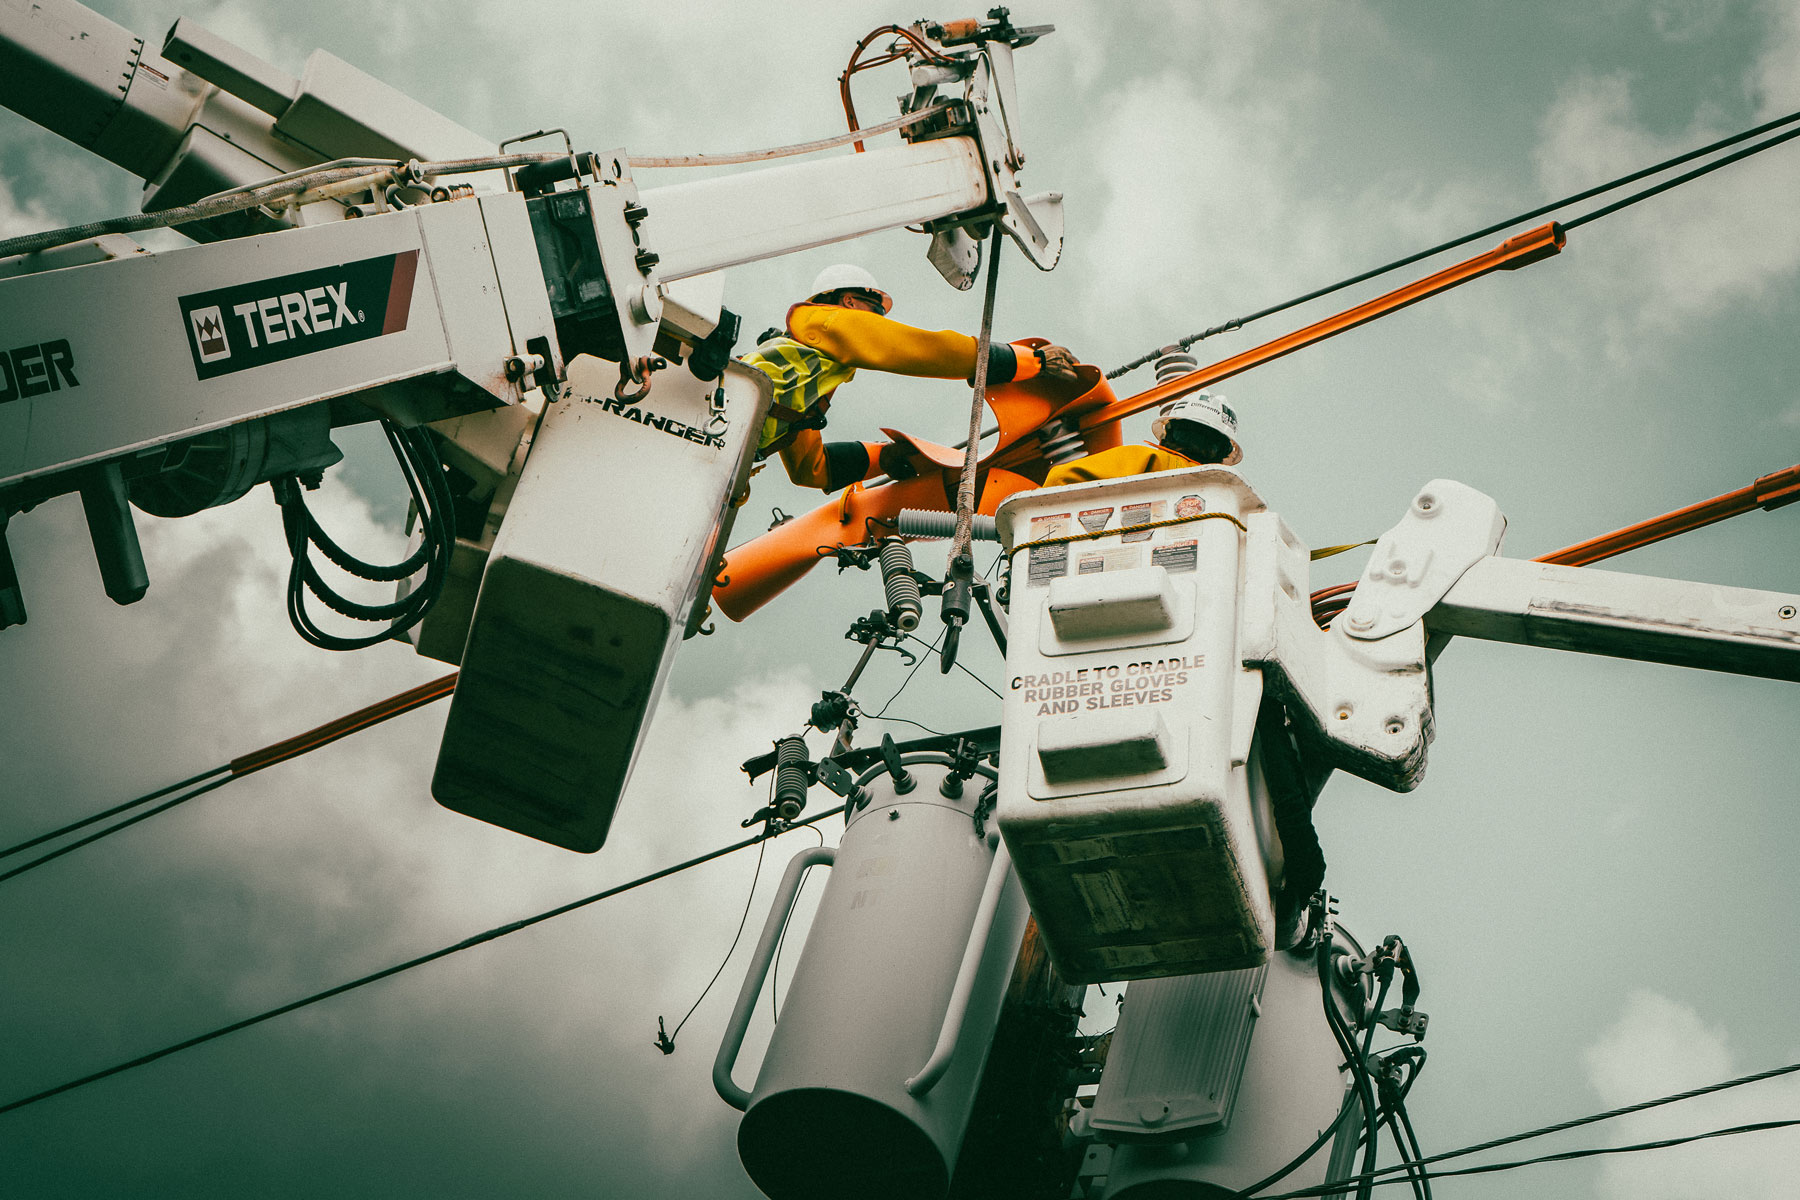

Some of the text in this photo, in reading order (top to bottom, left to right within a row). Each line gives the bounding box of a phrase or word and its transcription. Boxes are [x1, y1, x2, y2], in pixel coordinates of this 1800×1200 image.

[1011, 655, 1206, 690] CRADLE TO CRADLE
[1024, 671, 1188, 703] RUBBER GLOVES
[1037, 688, 1173, 716] AND SLEEVES
